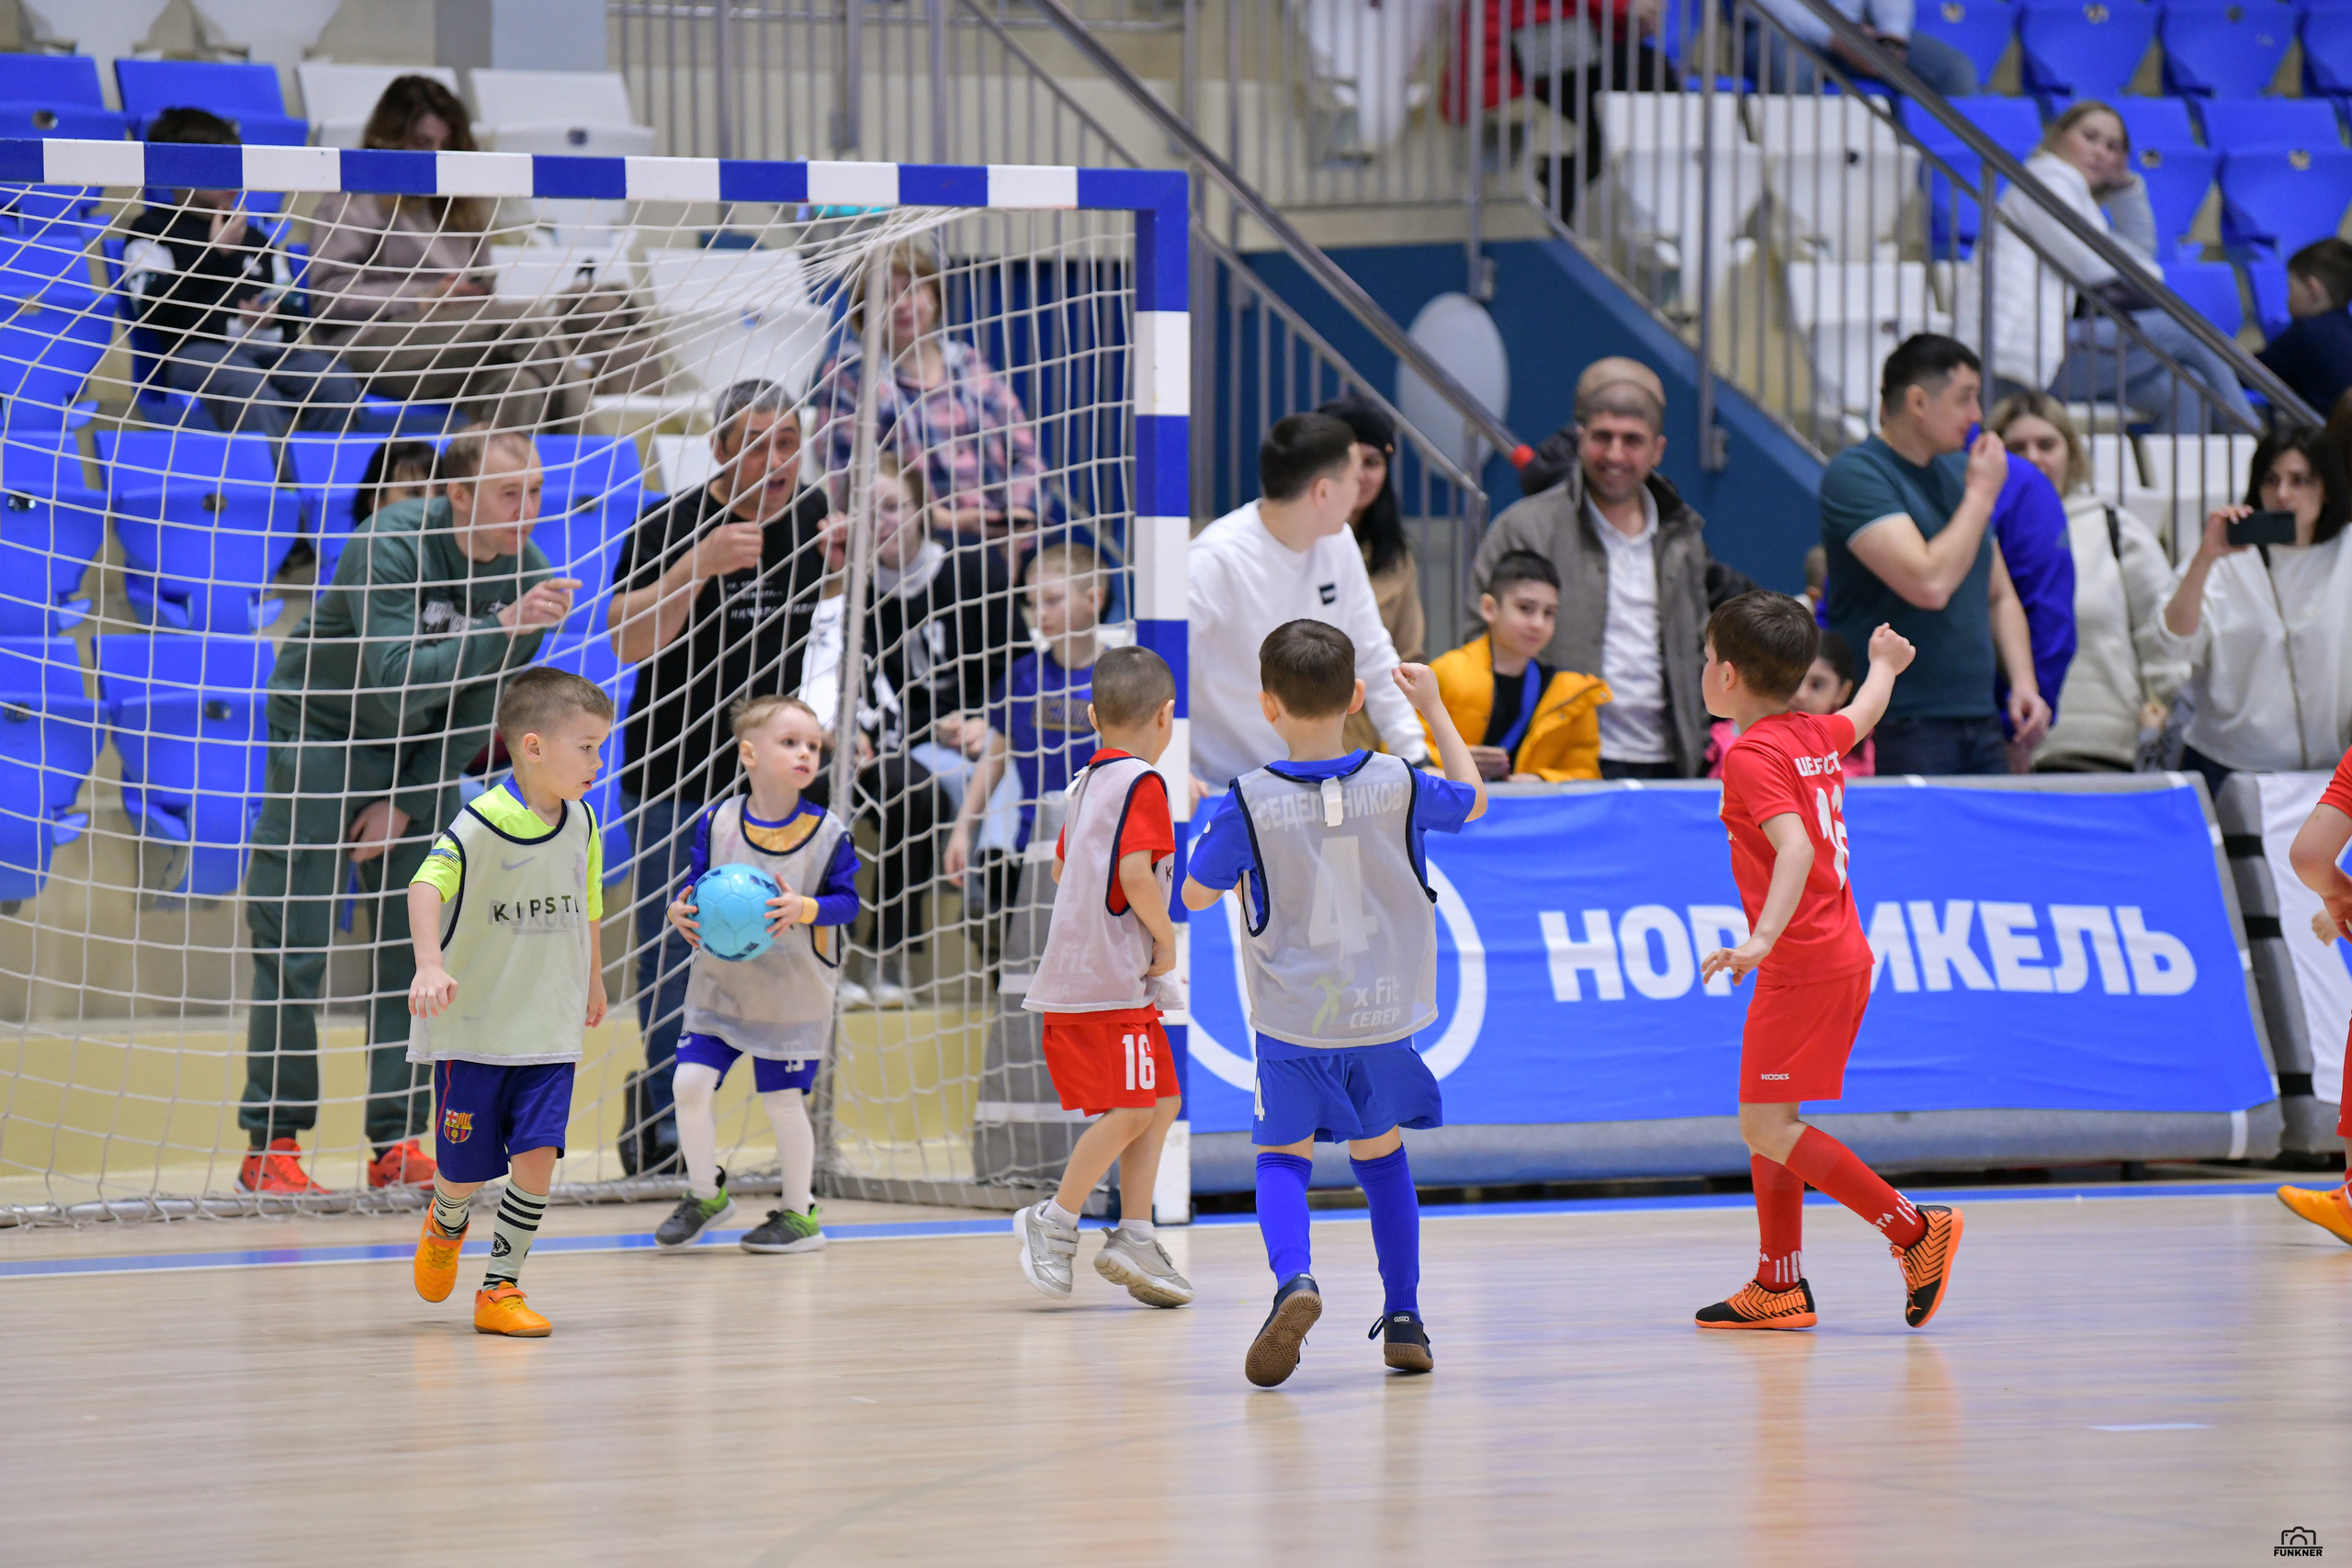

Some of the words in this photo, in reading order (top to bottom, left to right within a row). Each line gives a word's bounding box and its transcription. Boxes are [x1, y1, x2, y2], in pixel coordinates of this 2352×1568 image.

[1256, 782, 1408, 832] СЕДЕЛНИКОВ
[1308, 835, 1379, 953] 4
[1538, 898, 2198, 1003] НОРИКЕЛЬ
[1349, 1007, 1402, 1030] СЕВЕР
[1122, 1033, 1156, 1091] 16
[1762, 1291, 1808, 1316] PUMA
